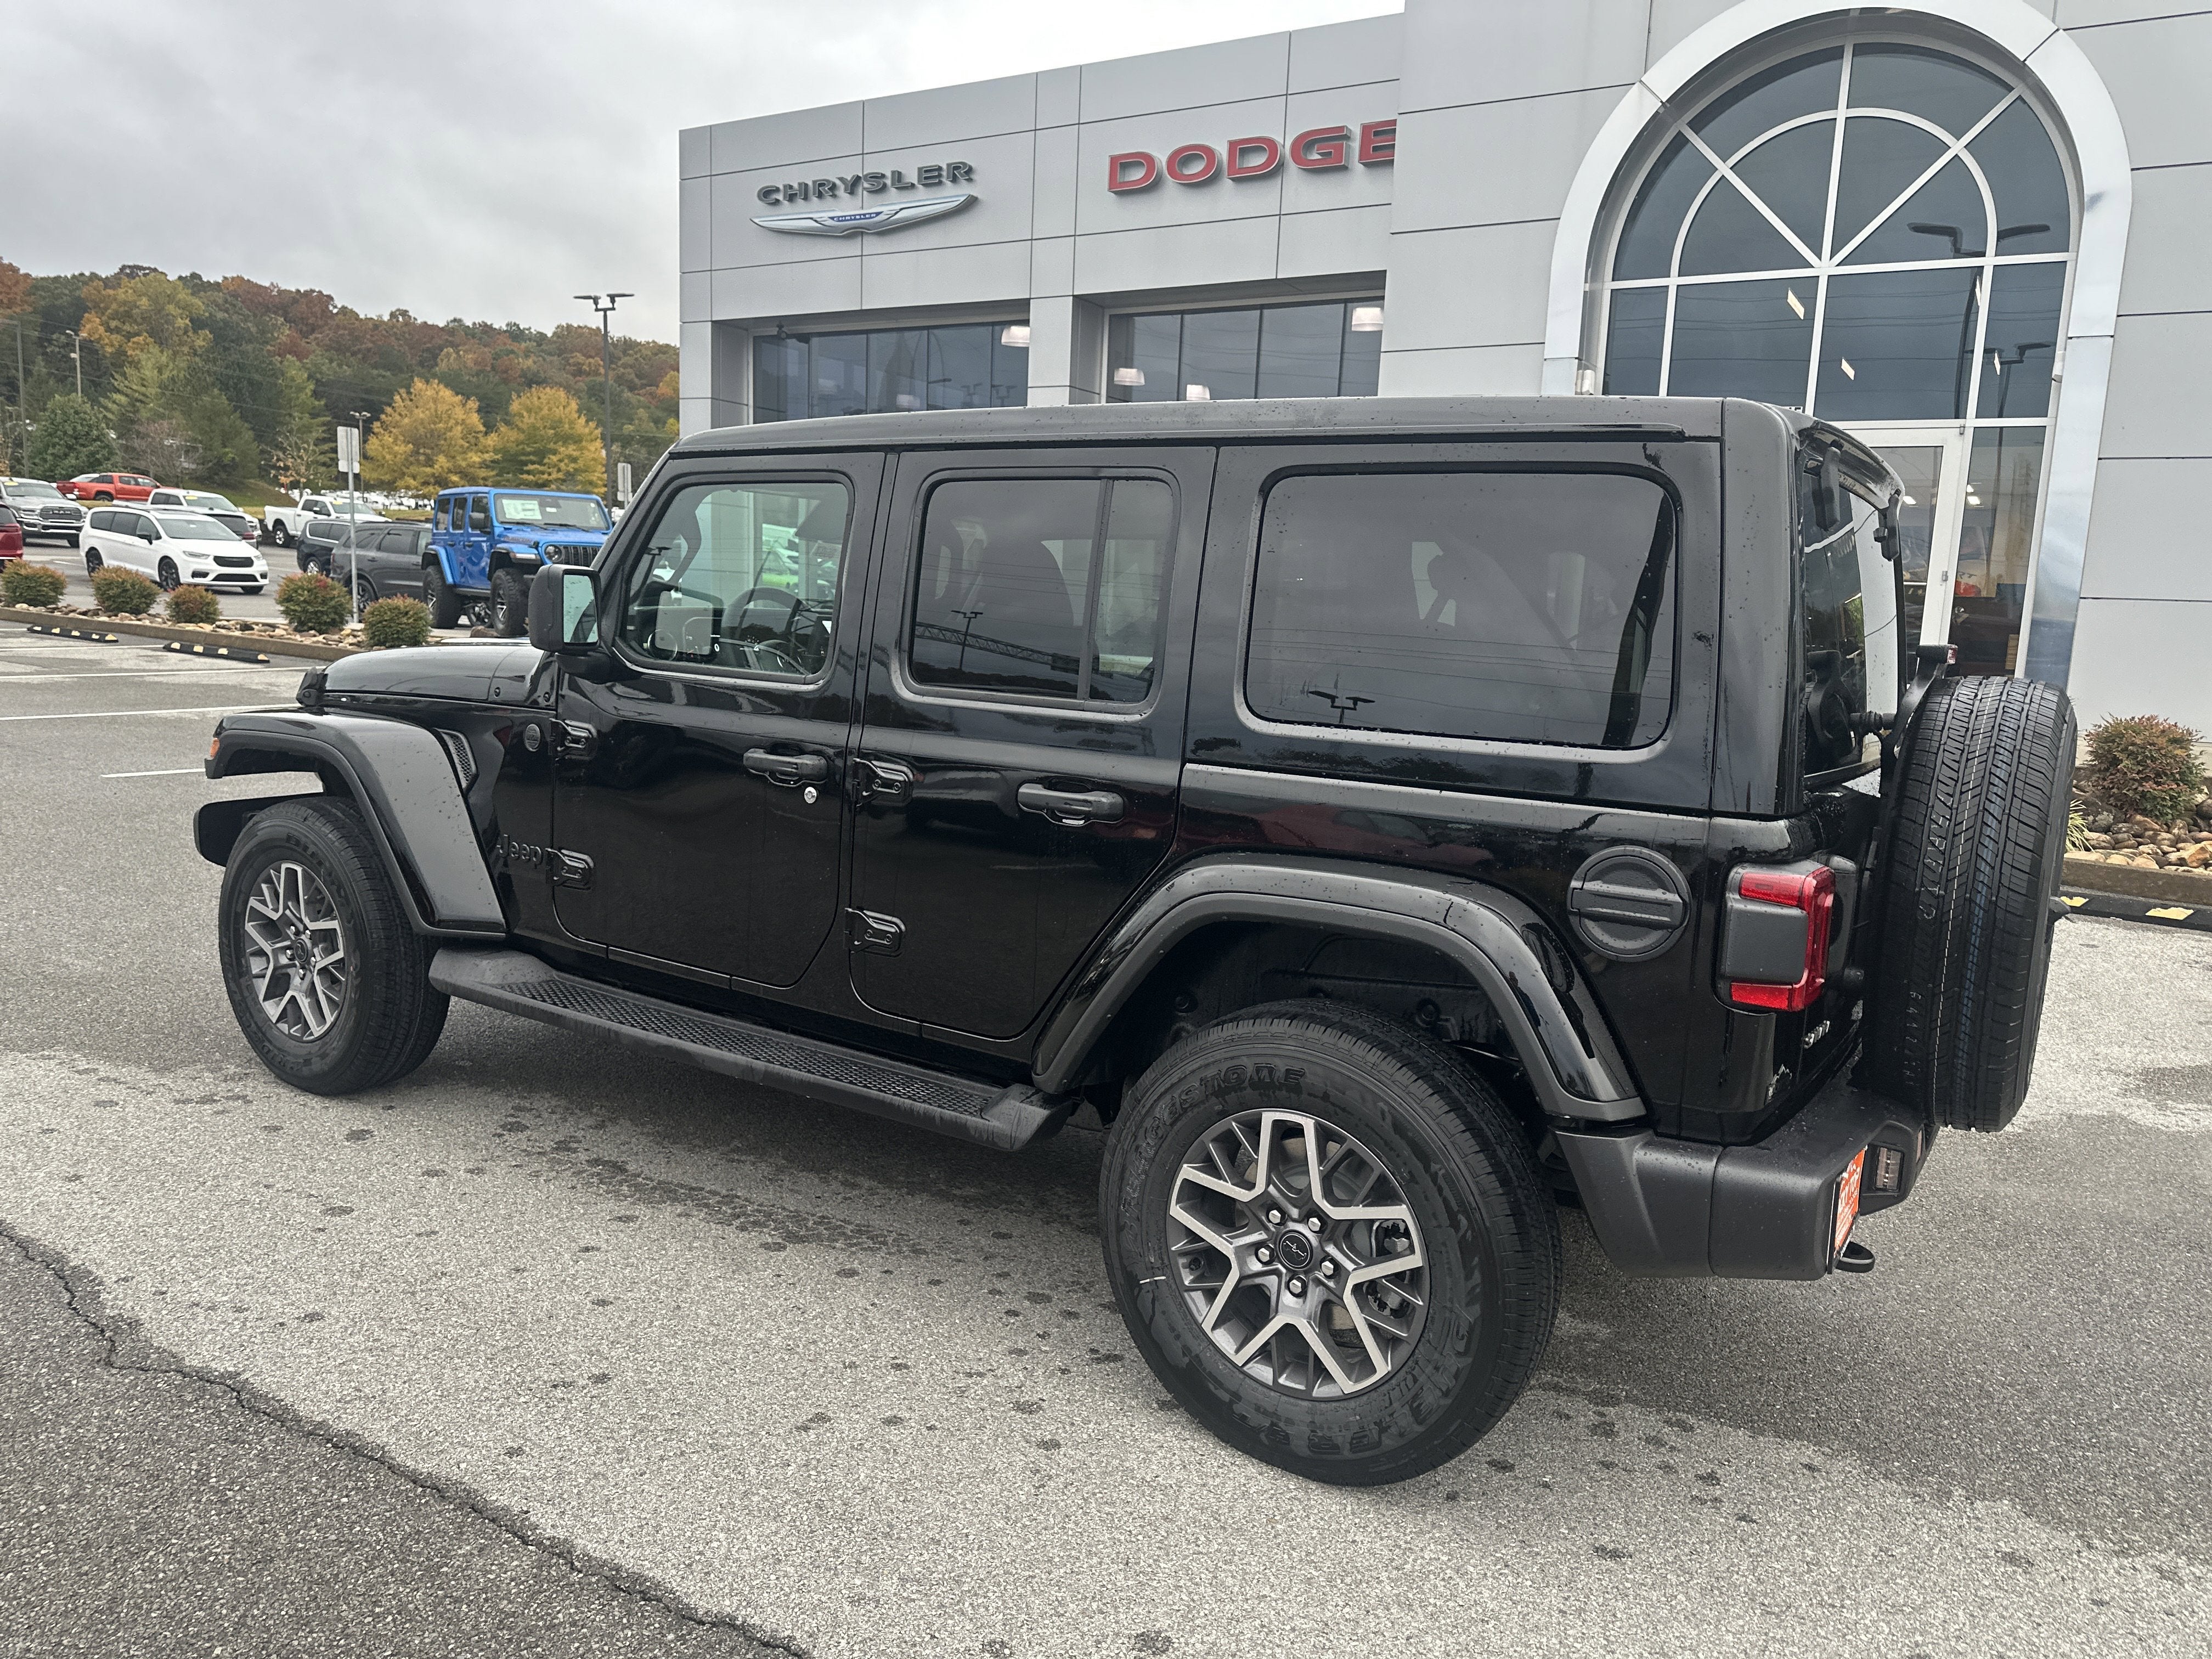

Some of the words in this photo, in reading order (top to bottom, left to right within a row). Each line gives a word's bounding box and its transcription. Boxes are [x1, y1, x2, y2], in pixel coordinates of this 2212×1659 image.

[1108, 119, 1397, 195] DODGE
[757, 160, 973, 205] CHRYSLER
[496, 834, 543, 869] Jeep
